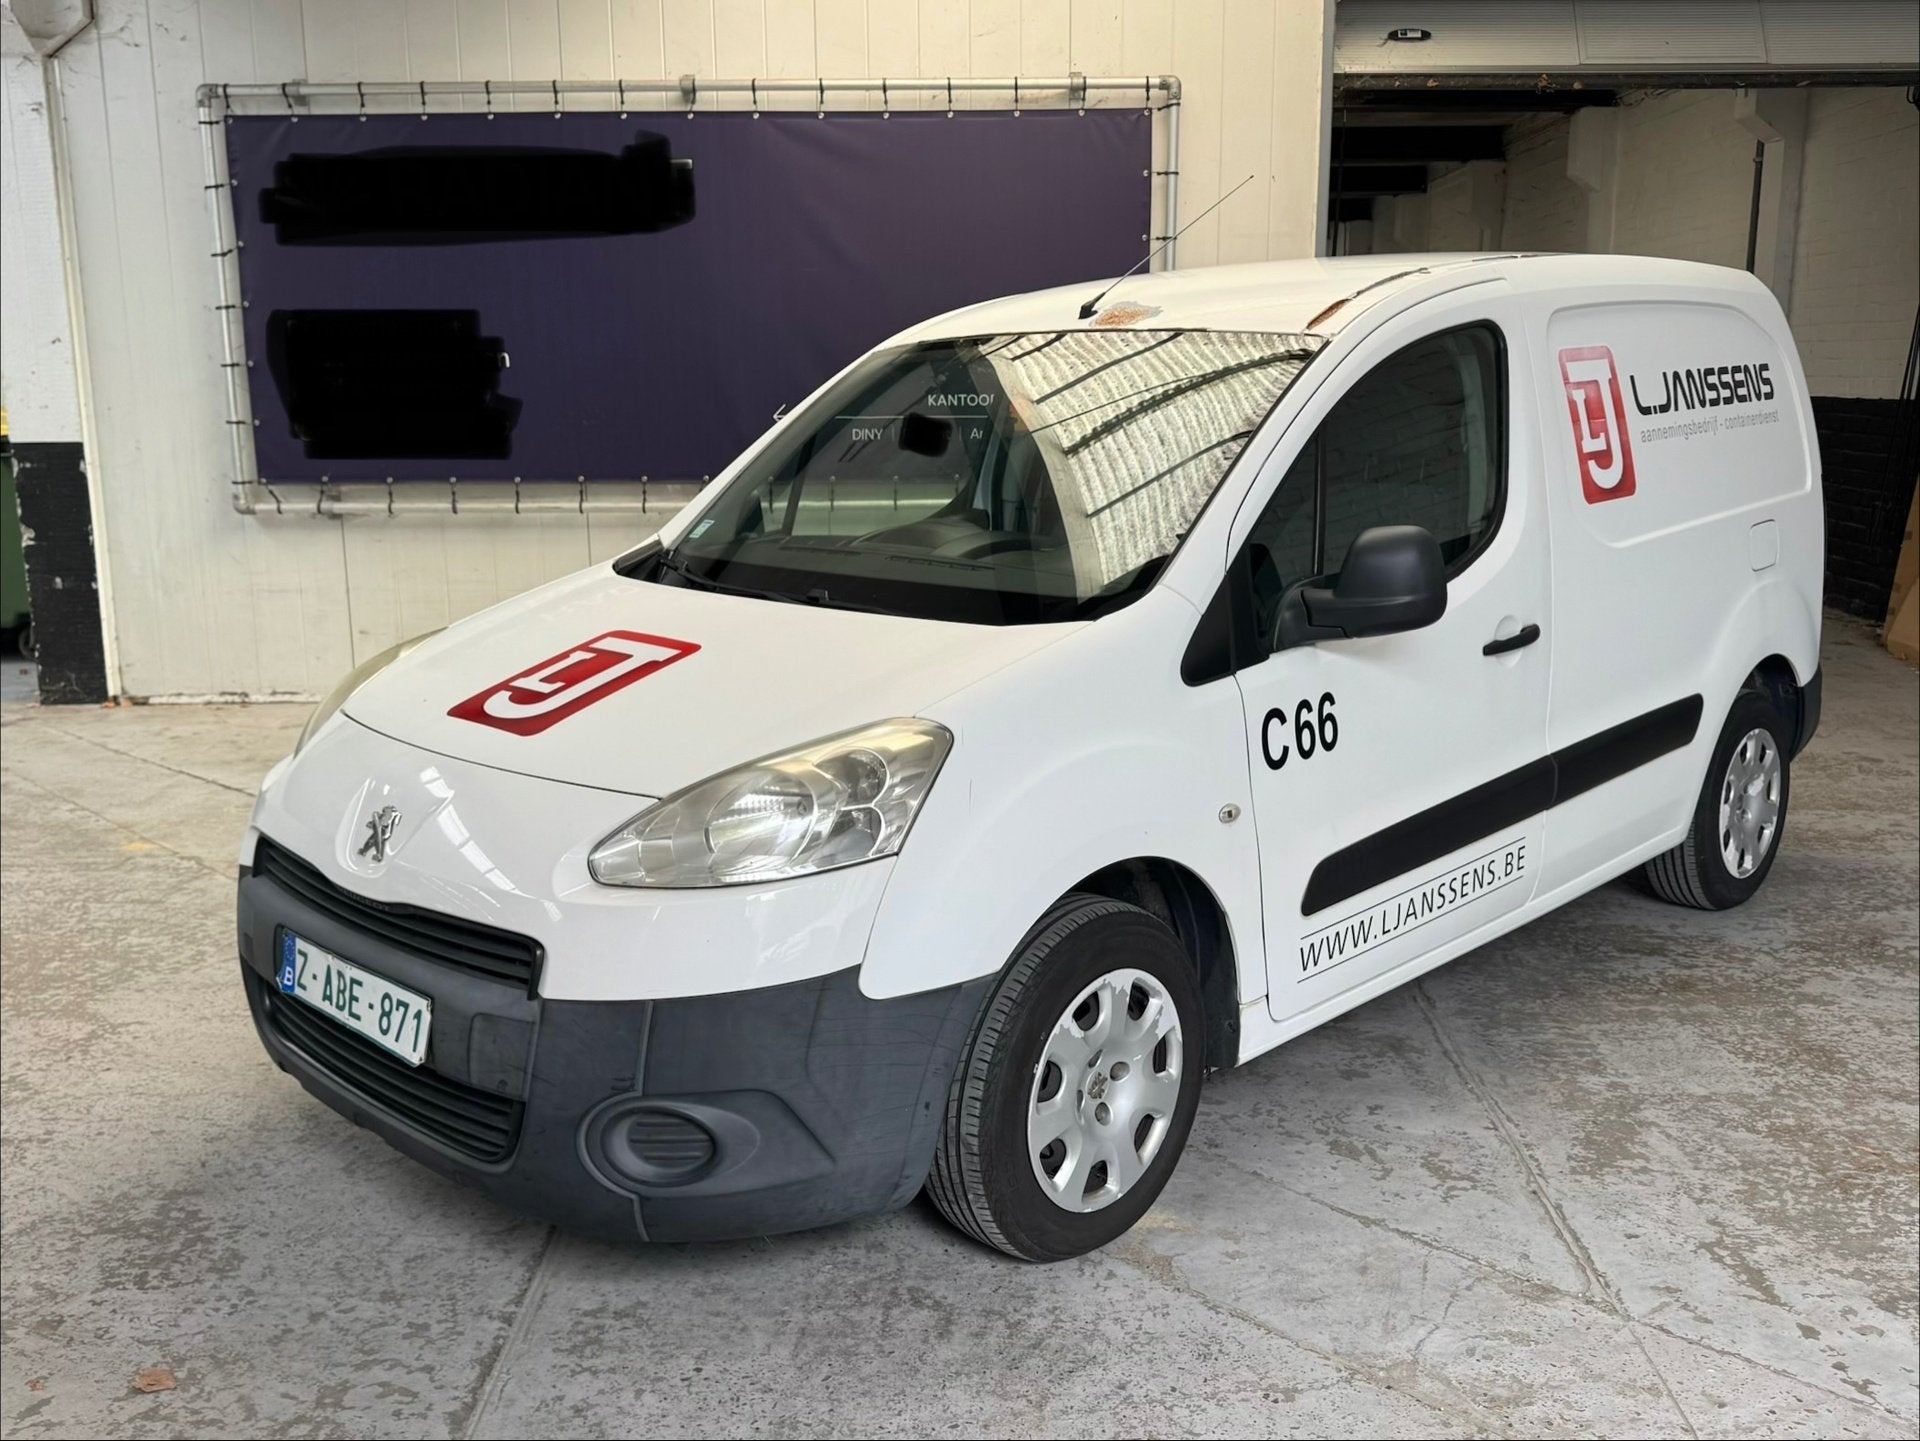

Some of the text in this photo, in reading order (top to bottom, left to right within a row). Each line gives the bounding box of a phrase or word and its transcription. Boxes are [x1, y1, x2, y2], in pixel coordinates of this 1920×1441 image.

[1629, 362, 1775, 416] L.JANSSENS
[851, 427, 884, 441] DINY
[1640, 415, 1719, 443] aannemingsbedrijf
[1725, 409, 1780, 431] containerdienst
[1299, 845, 1527, 972] WWW.LJANSSENS.BE
[282, 948, 423, 1053] B Z-ABE-871
